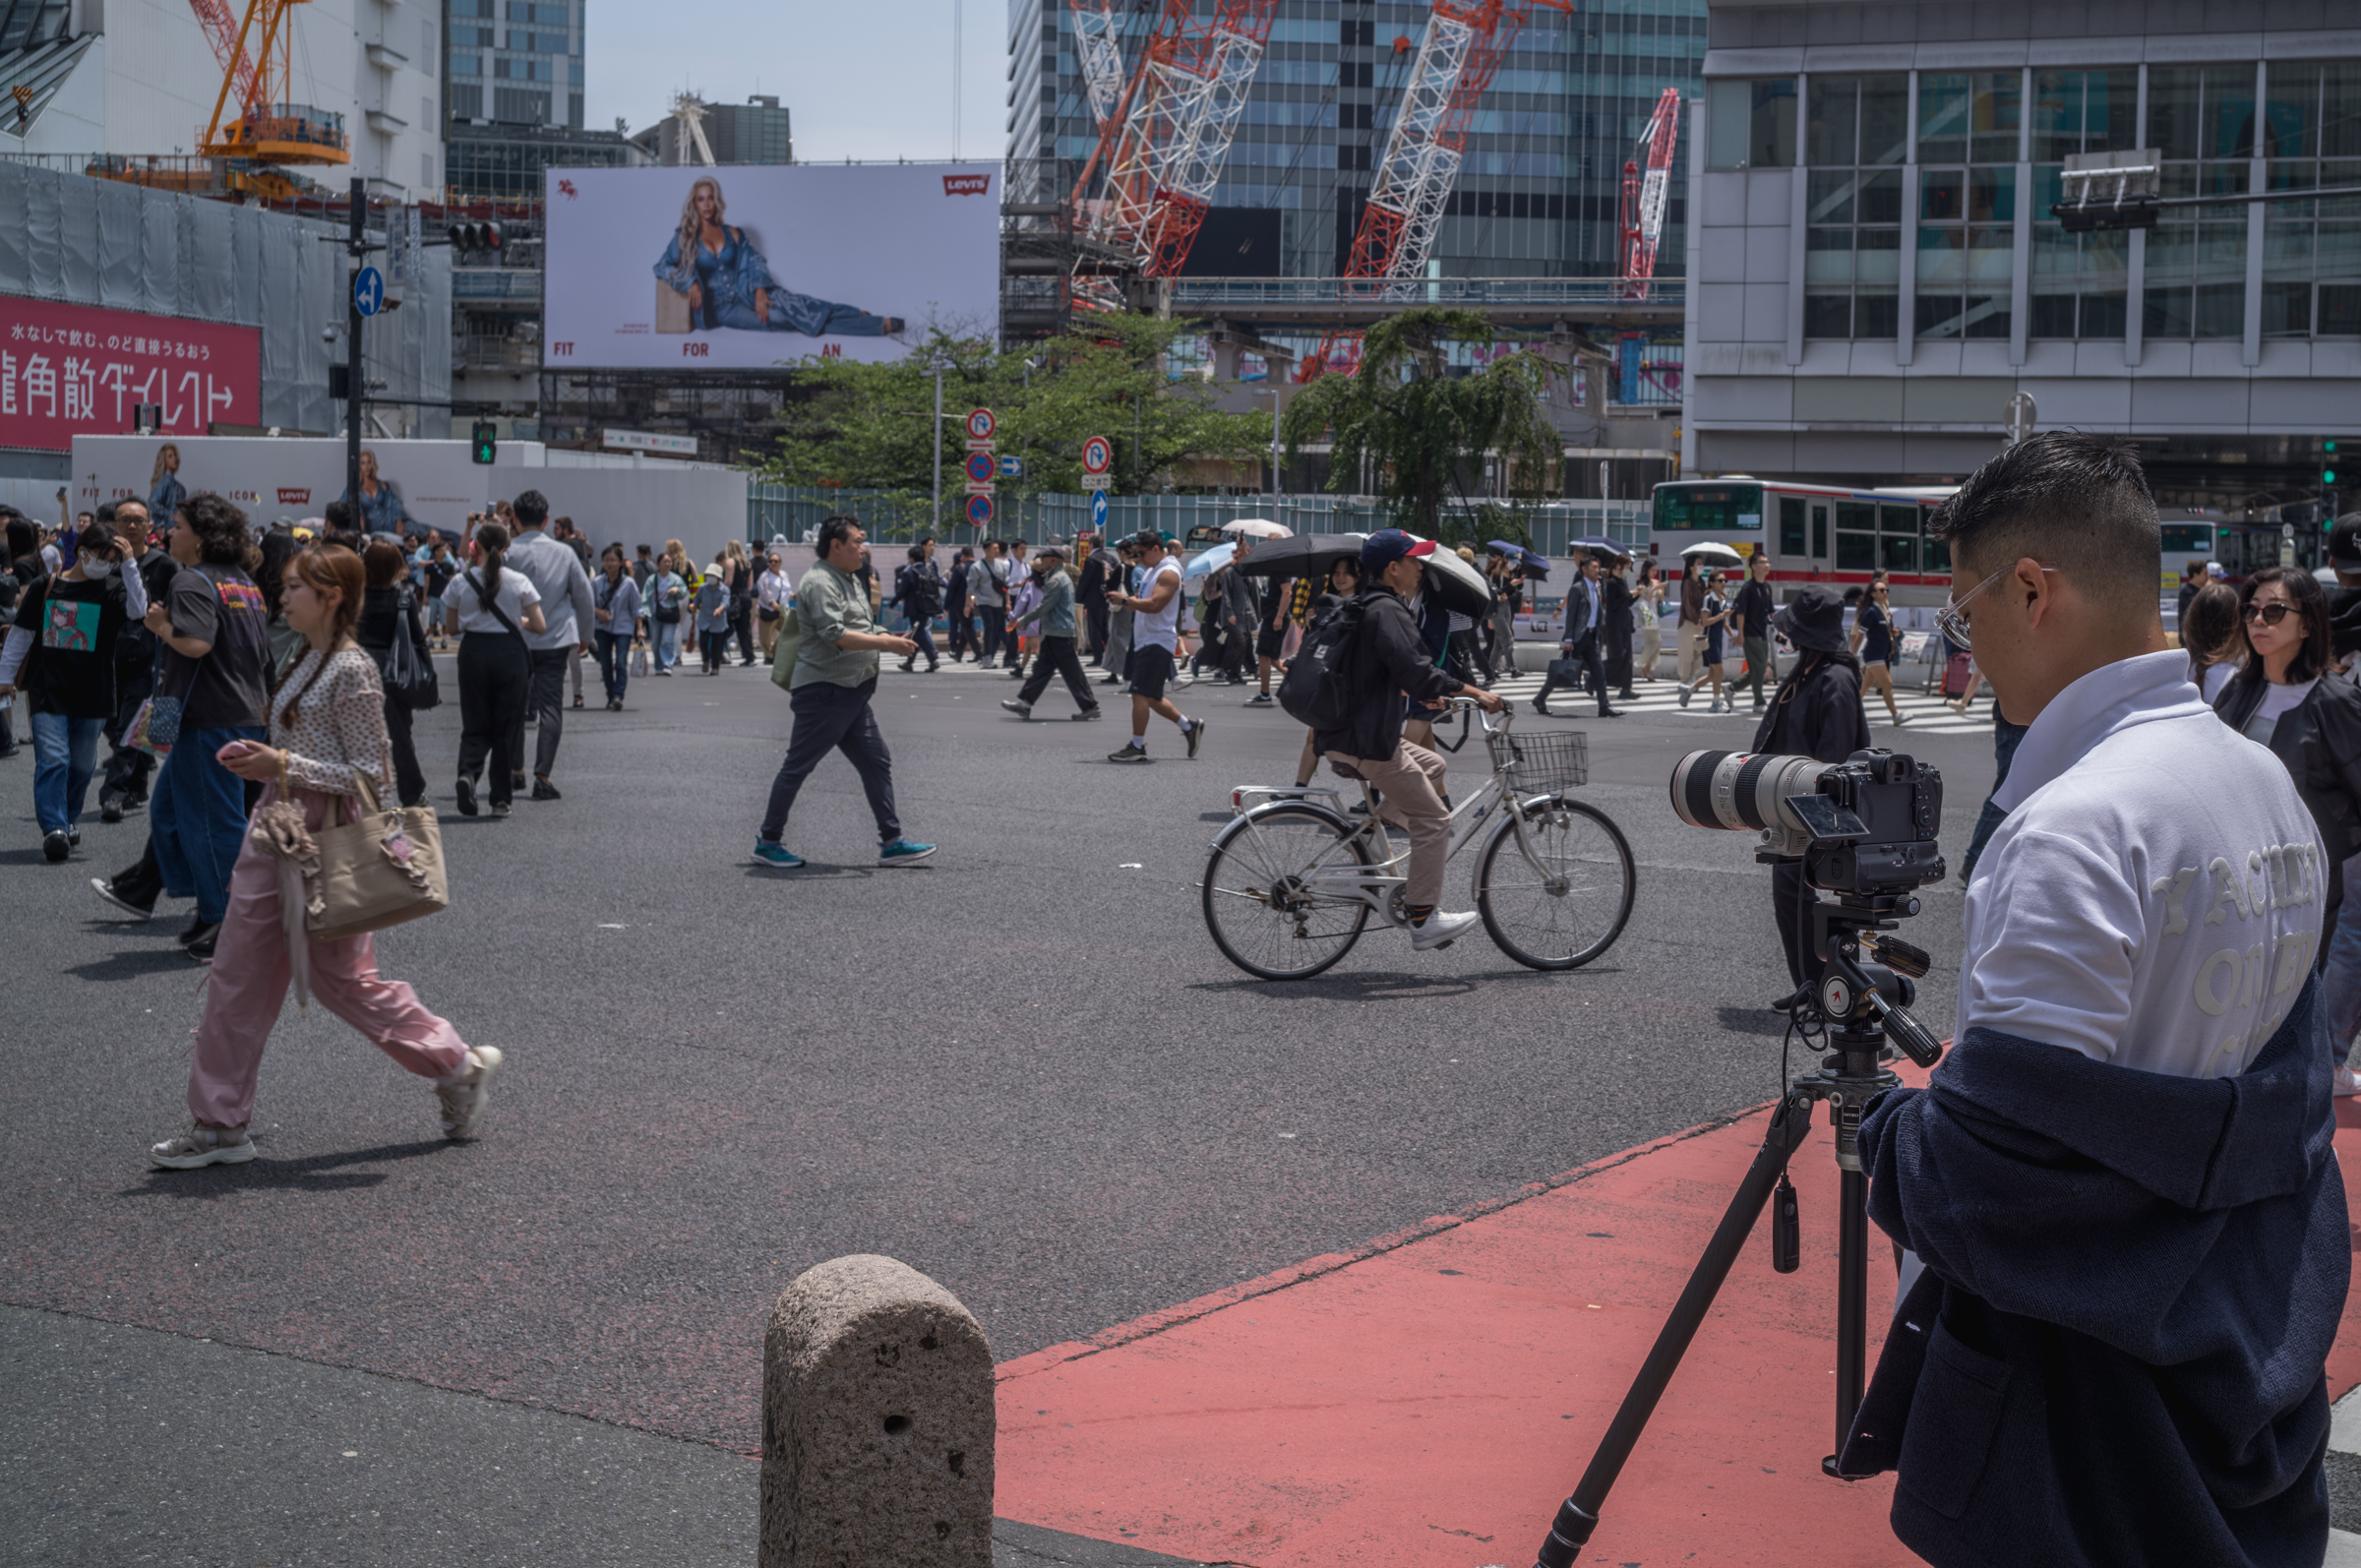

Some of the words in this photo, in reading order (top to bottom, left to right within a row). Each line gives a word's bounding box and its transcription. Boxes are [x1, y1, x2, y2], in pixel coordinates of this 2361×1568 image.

[11, 323, 210, 361] 水なしで飲む、のど直接うるおう
[554, 341, 575, 356] FIT
[683, 342, 709, 357] FOR
[822, 343, 841, 357] AN
[83, 488, 100, 498] FIT
